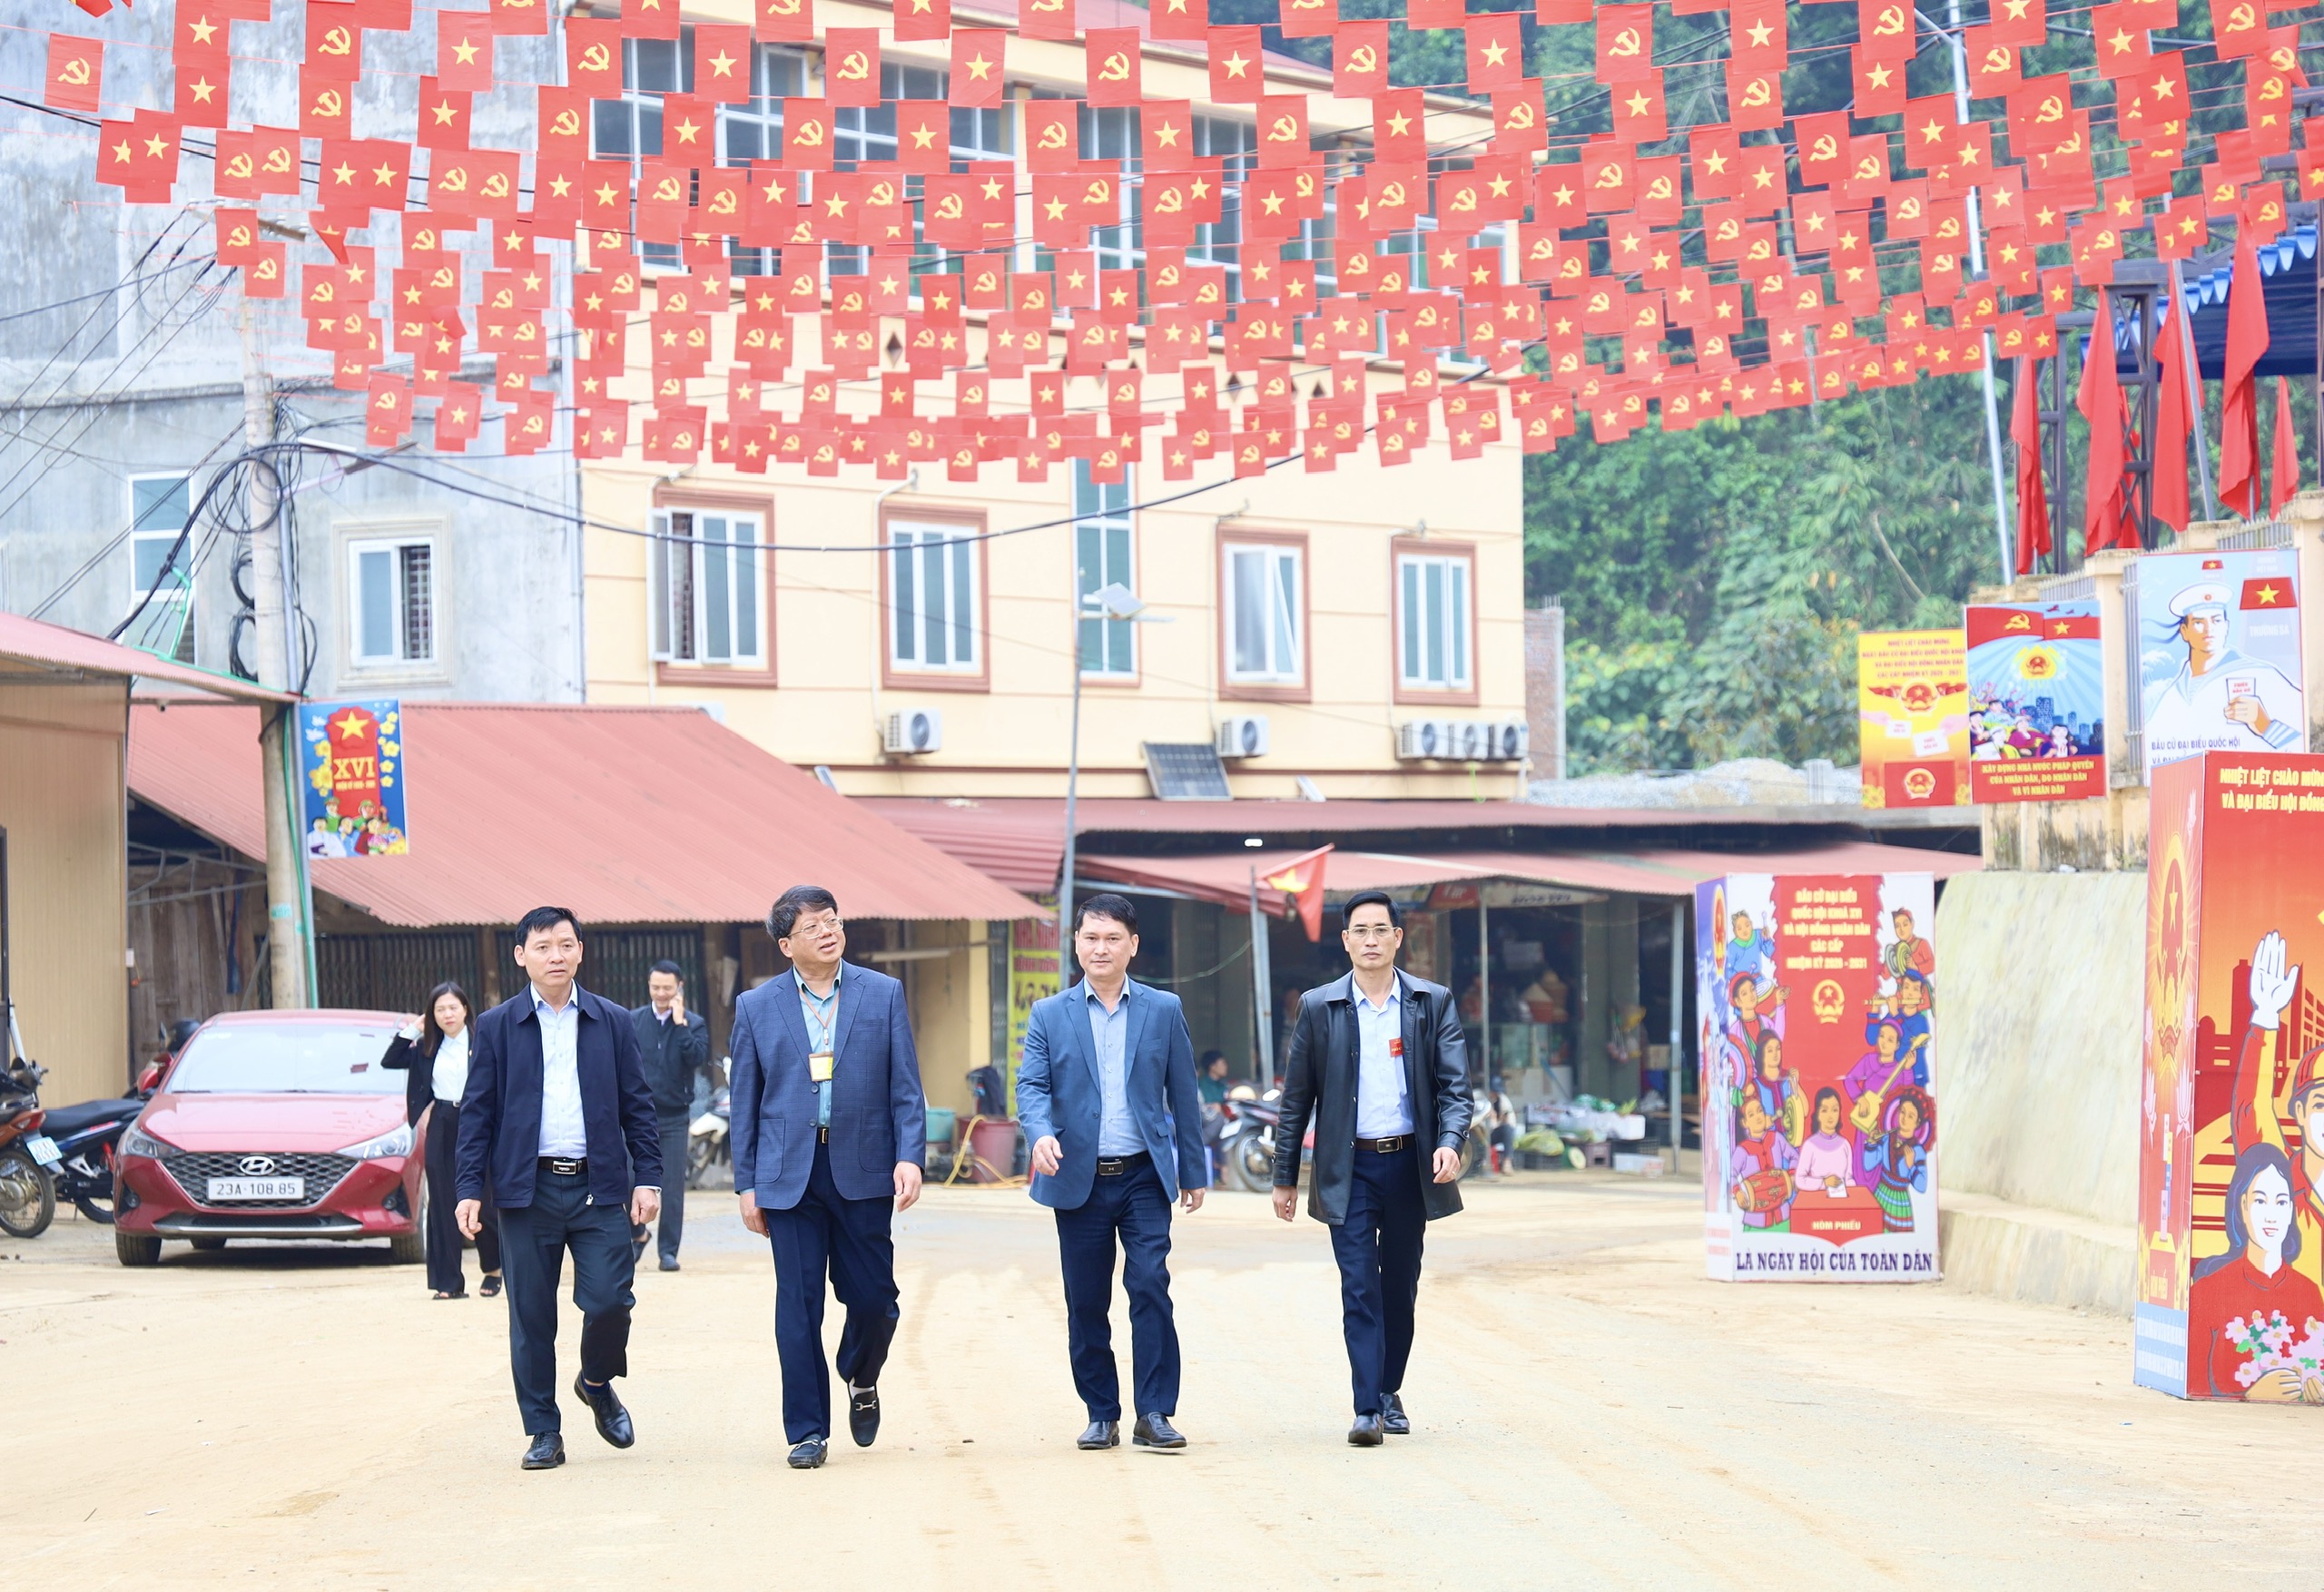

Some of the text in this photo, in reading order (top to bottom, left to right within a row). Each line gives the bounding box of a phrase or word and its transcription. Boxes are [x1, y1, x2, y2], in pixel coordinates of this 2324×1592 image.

[2209, 736, 2227, 748] QUỐC
[2229, 736, 2240, 749] HỘI
[333, 756, 375, 780] XVI
[2221, 766, 2249, 787] NHIỆT
[2250, 766, 2270, 788] LIỆT
[2272, 768, 2299, 786] CHÀO
[2222, 790, 2235, 809] VÀ
[2237, 793, 2254, 812] ĐẠI
[2256, 789, 2279, 810] BIỂU
[2280, 792, 2297, 813] HỘI
[1849, 908, 1862, 919] XVI
[1737, 1247, 1753, 1271] LÀ
[1758, 1247, 1795, 1271] NGÀY
[1799, 1247, 1824, 1275] HỘI
[1830, 1247, 1856, 1271] CỦA
[1861, 1248, 1898, 1271] TOÀN
